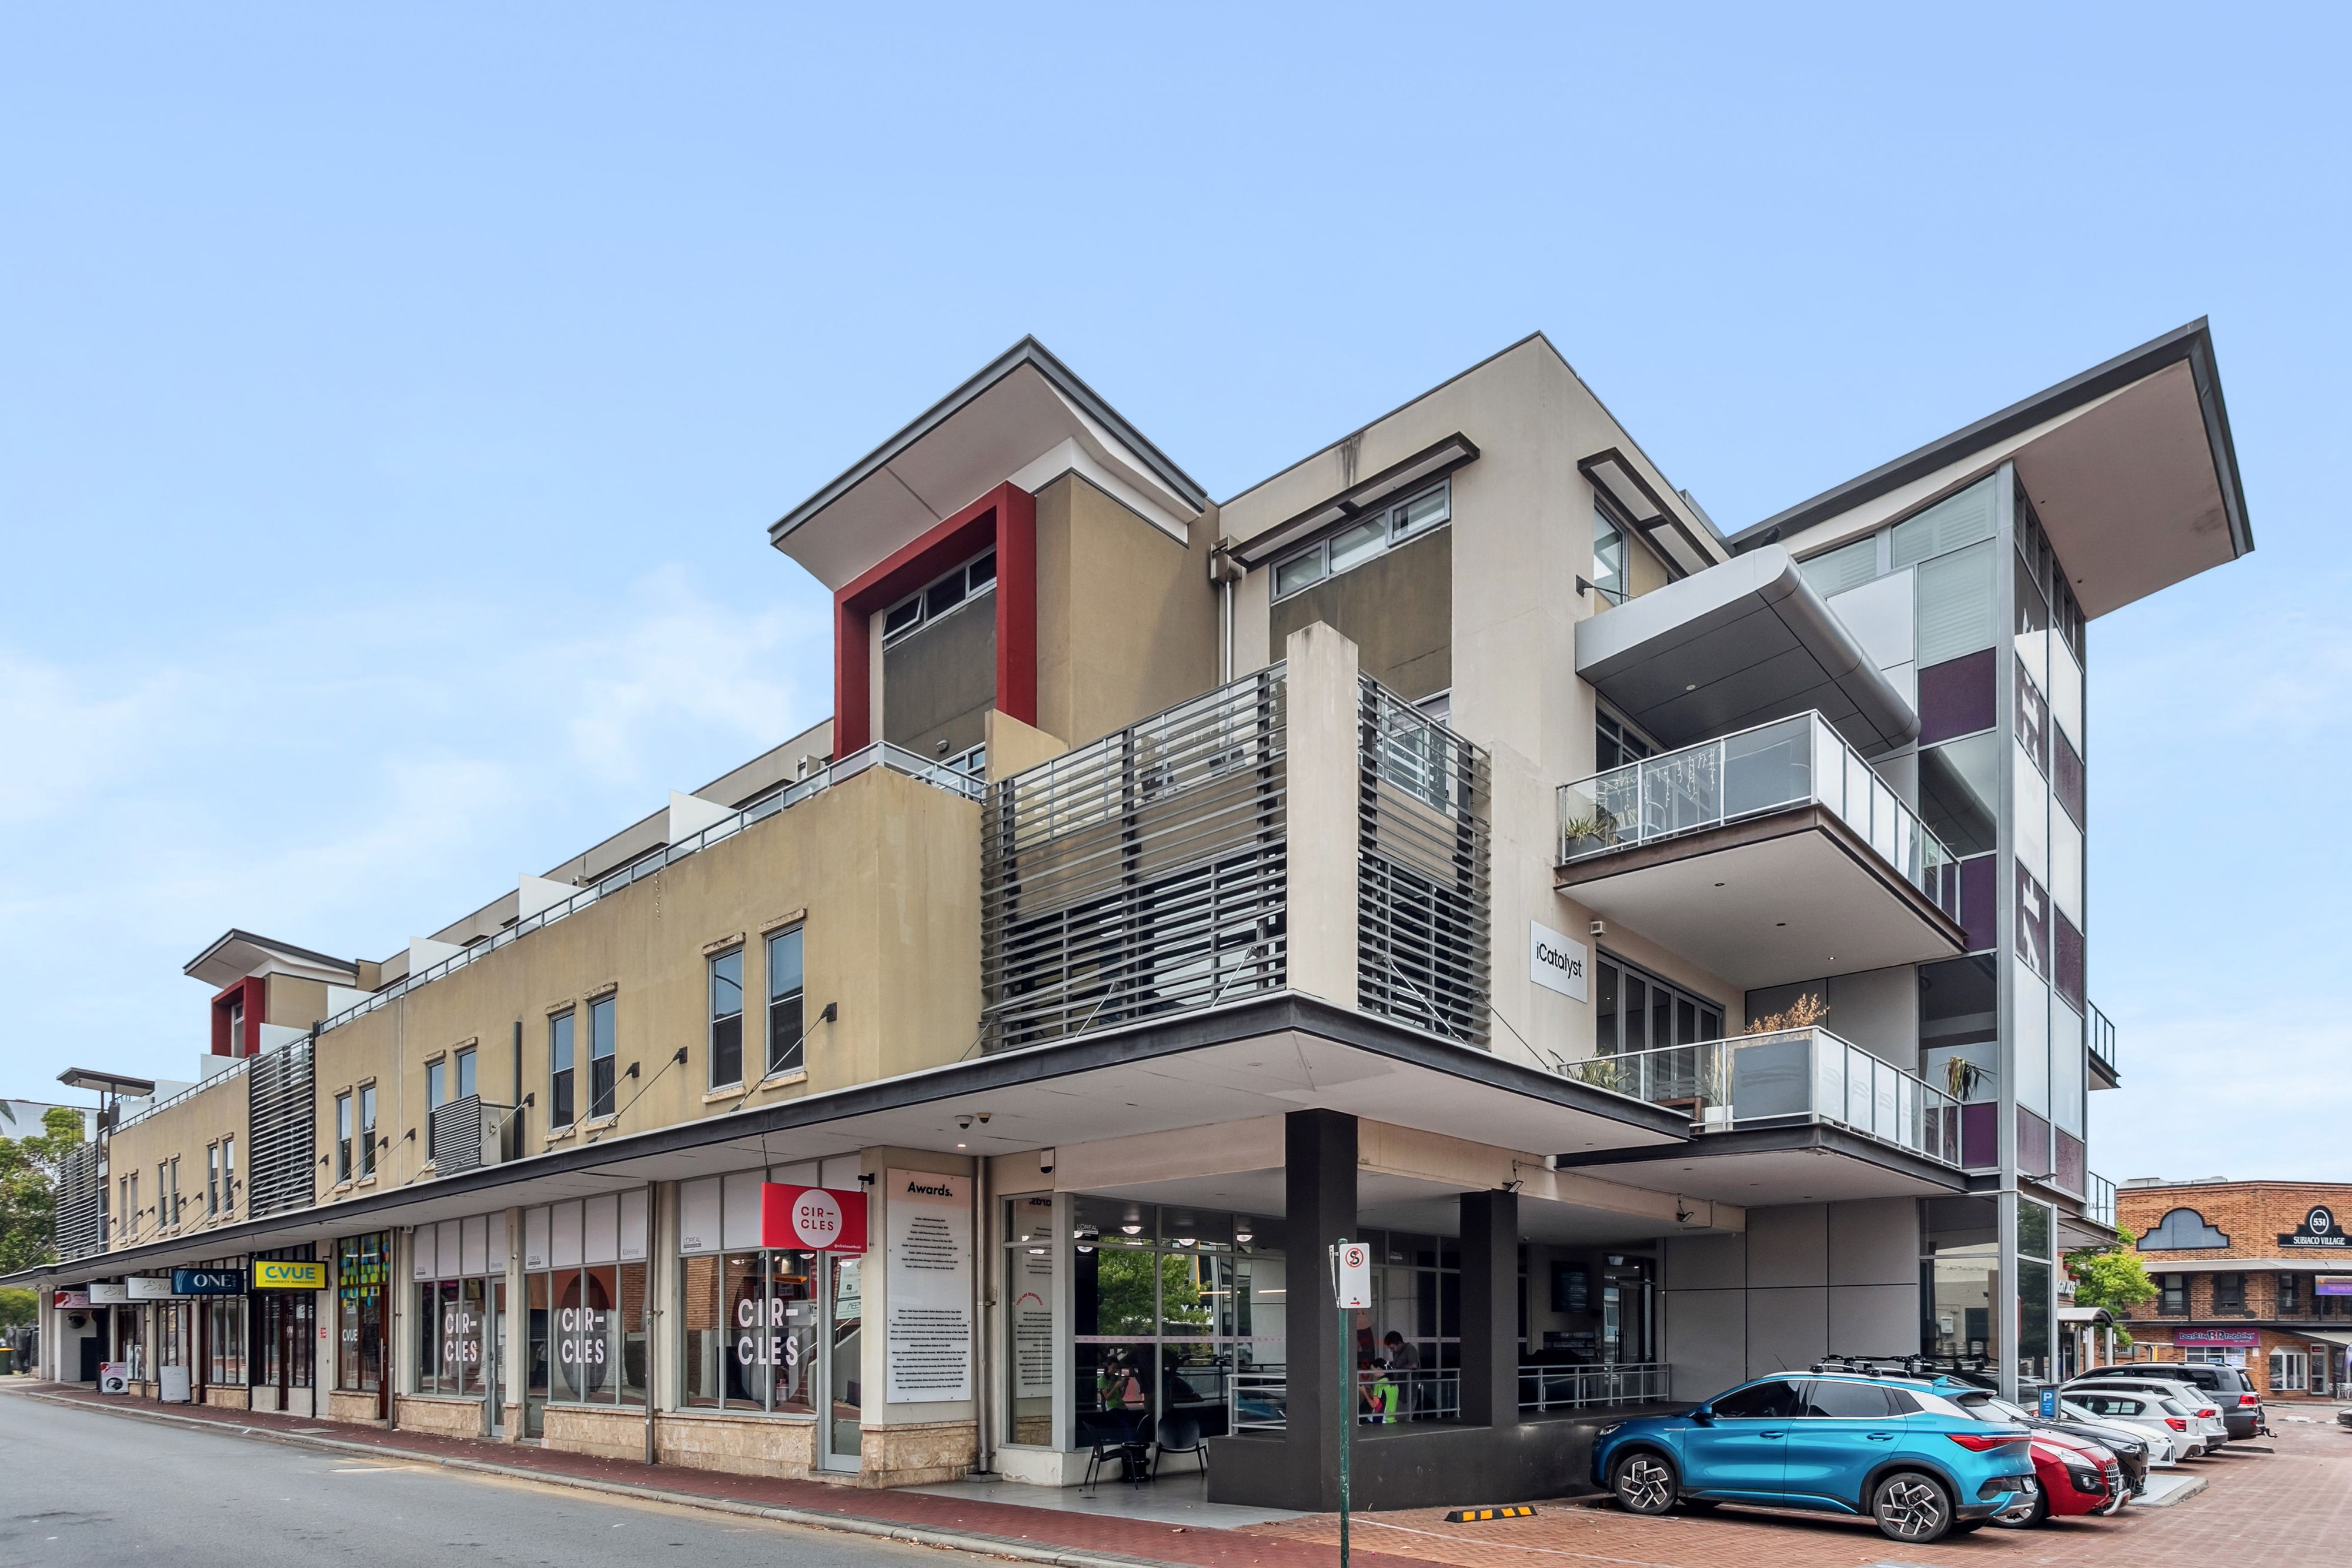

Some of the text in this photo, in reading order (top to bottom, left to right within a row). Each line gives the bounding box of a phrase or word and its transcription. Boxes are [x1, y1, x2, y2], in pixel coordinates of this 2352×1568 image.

[1536, 941, 1582, 979] iCatalyst
[907, 1181, 953, 1197] Awards.
[801, 1206, 834, 1218] CIR-
[801, 1219, 834, 1231] CLES
[2293, 1236, 2345, 1245] SUBIACO VILLAGE
[265, 1266, 315, 1279] CVUE
[193, 1274, 232, 1287] ONE
[562, 1307, 604, 1332] CIR-
[738, 1298, 798, 1328] CIR-
[445, 1313, 477, 1334] CIR-
[342, 1329, 358, 1341] CVUE
[2179, 1332, 2208, 1340] baskin
[2207, 1329, 2225, 1340] BR
[445, 1340, 477, 1362] CLES
[562, 1339, 604, 1363] CLES
[738, 1336, 798, 1366] CLES
[2043, 1392, 2053, 1402] P
